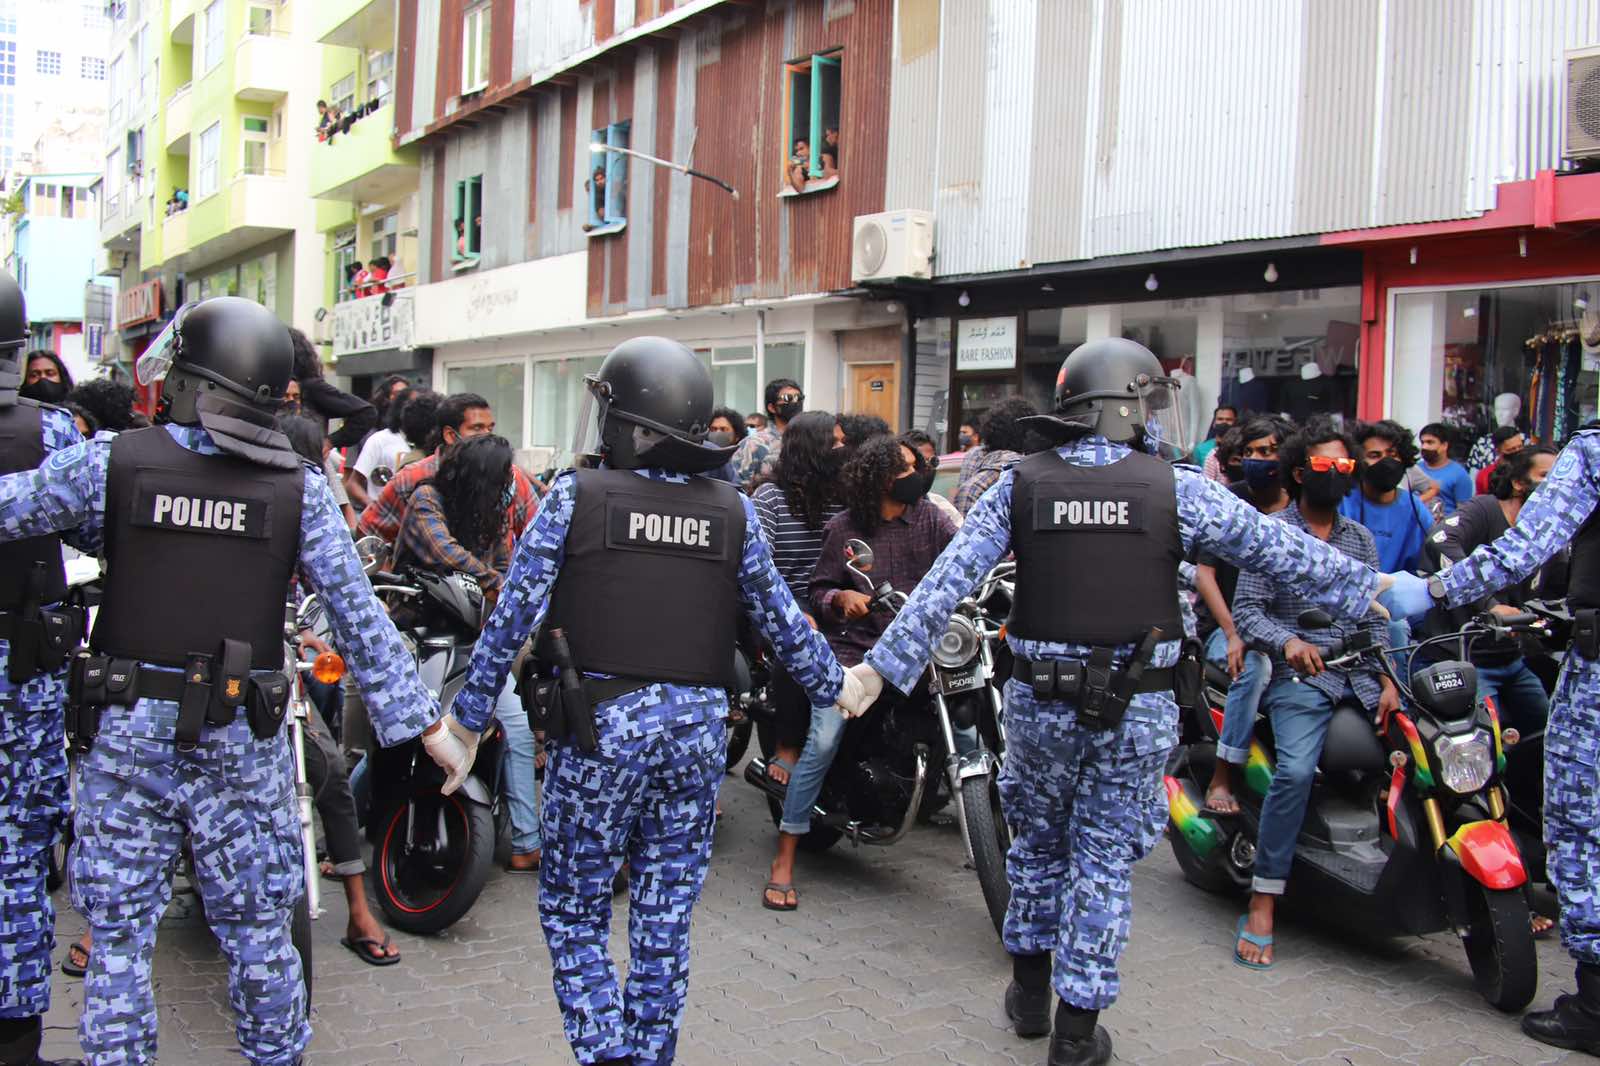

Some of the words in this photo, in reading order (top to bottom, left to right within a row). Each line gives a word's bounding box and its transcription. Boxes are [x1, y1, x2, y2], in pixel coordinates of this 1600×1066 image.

[960, 348, 978, 361] RARE
[981, 346, 1014, 361] FASHION
[153, 494, 247, 532] POLICE
[1053, 500, 1129, 525] POLICE
[628, 512, 711, 547] POLICE
[1435, 678, 1463, 690] P5024
